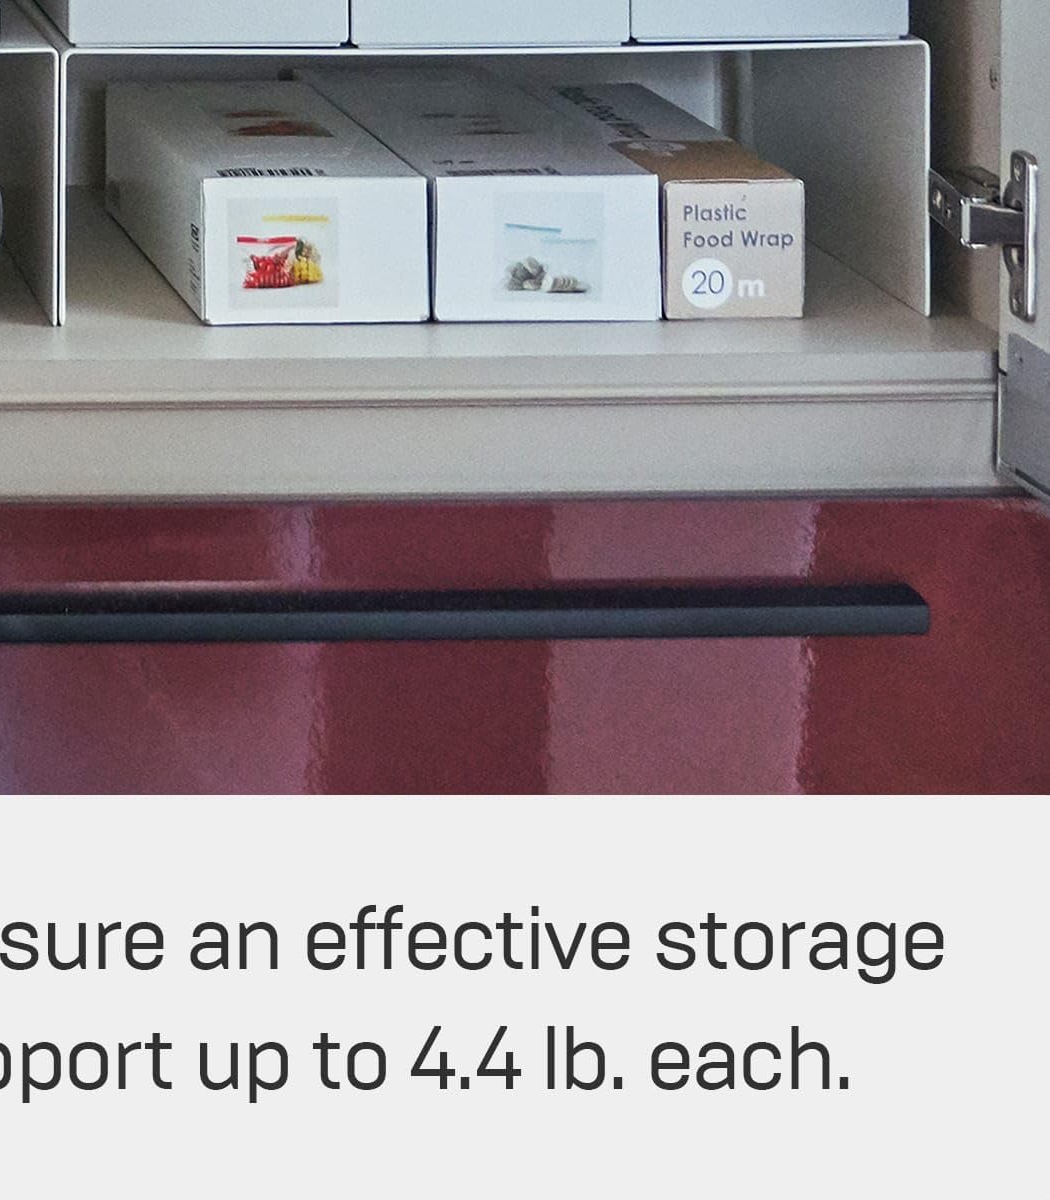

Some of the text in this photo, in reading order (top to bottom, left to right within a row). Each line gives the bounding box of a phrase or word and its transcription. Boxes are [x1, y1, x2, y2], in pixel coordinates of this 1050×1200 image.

[683, 204, 747, 221] Plastic
[683, 230, 794, 249] Food Wrap
[691, 270, 765, 297] 20 m
